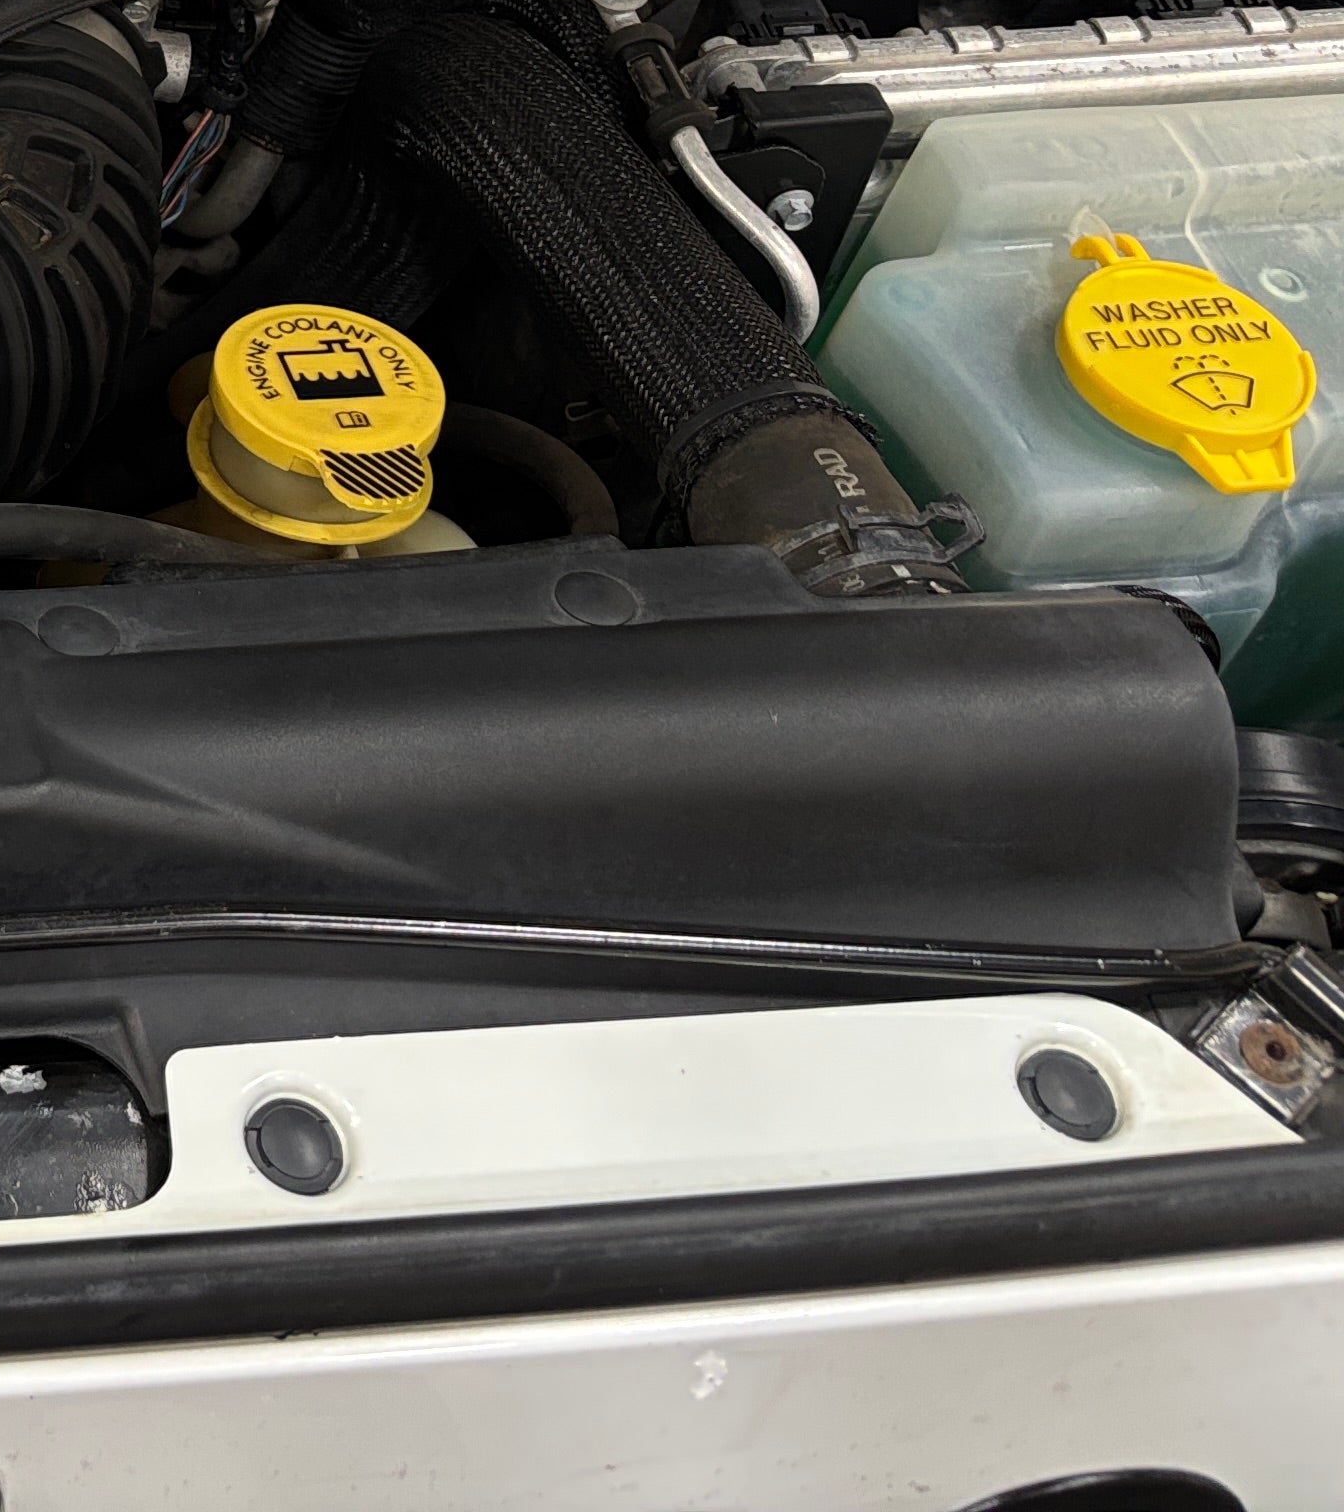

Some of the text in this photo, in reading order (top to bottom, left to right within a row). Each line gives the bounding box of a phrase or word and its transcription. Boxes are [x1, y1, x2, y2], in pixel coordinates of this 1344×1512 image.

[1091, 297, 1239, 323] WASHER
[1085, 320, 1272, 352] FLUID ONLY
[245, 317, 417, 401] ENGINE COOLANT ONLY
[813, 447, 867, 498] RAD
